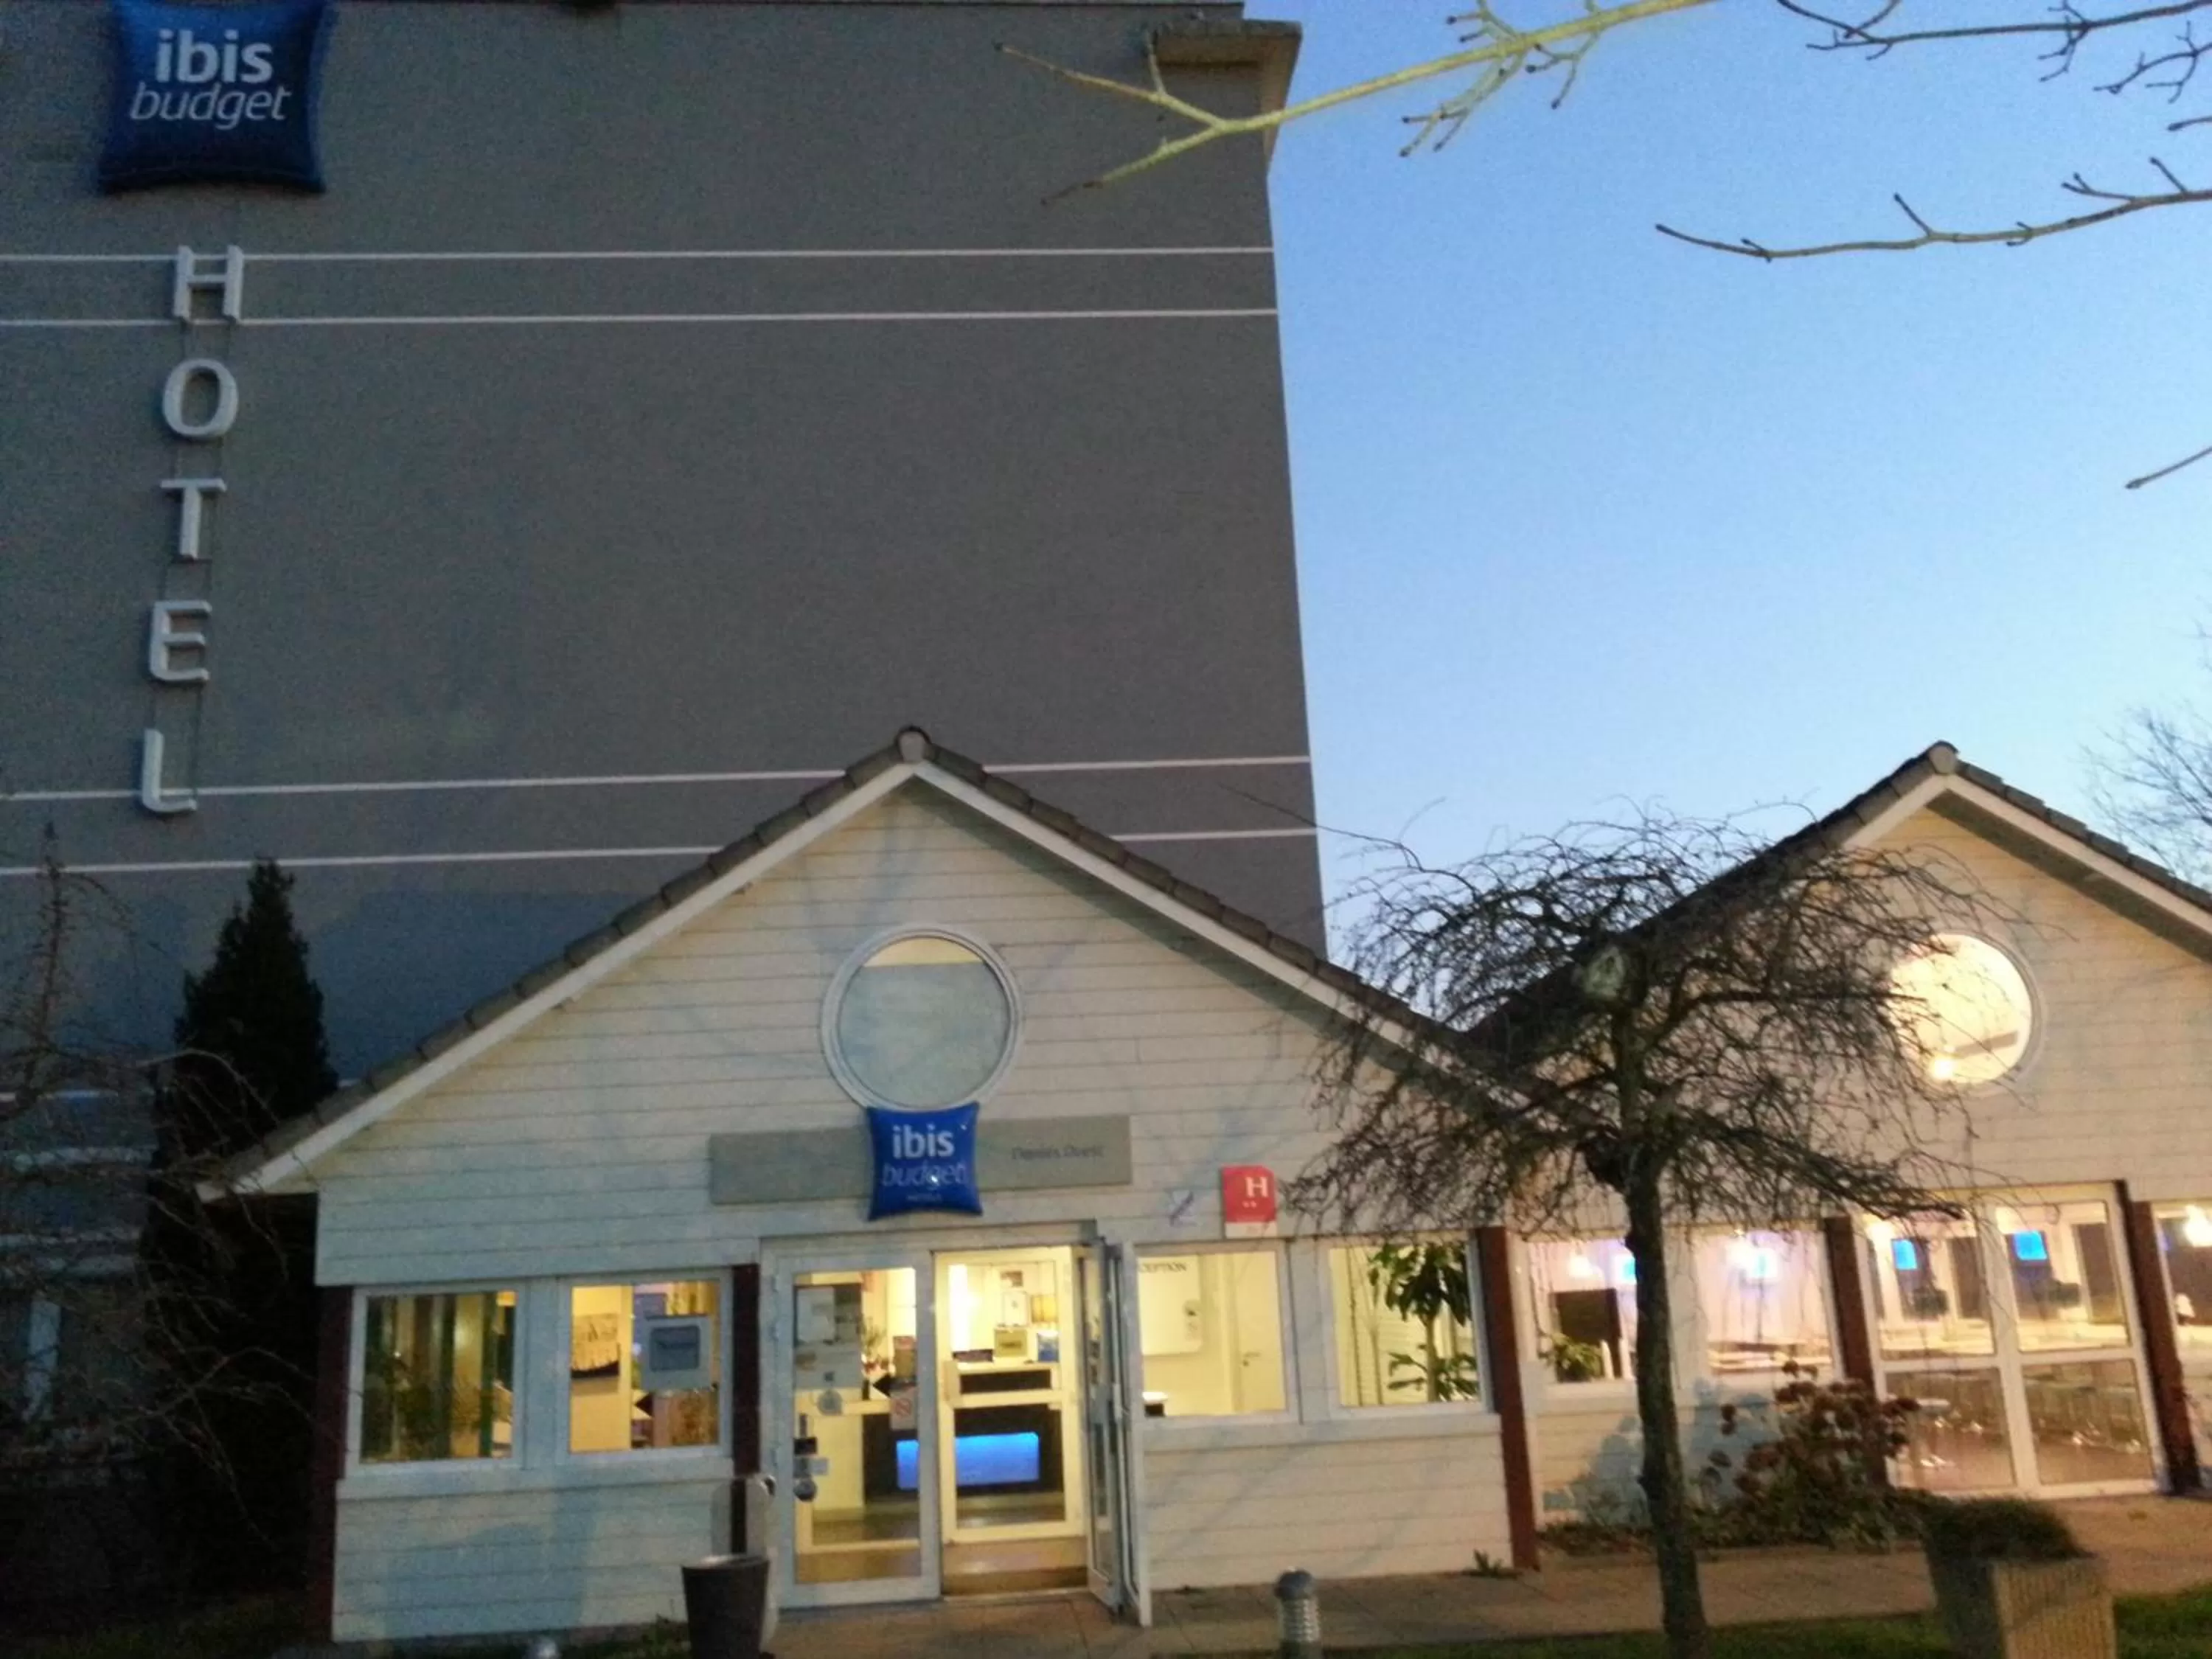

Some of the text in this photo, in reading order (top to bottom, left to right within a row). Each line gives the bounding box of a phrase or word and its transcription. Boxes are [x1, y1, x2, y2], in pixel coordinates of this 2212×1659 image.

[156, 29, 274, 83] ibis
[129, 81, 292, 131] budget
[141, 245, 244, 813] HOTEL
[892, 1123, 955, 1159] ibis
[882, 1161, 968, 1191] budget
[1245, 1176, 1268, 1197] H
